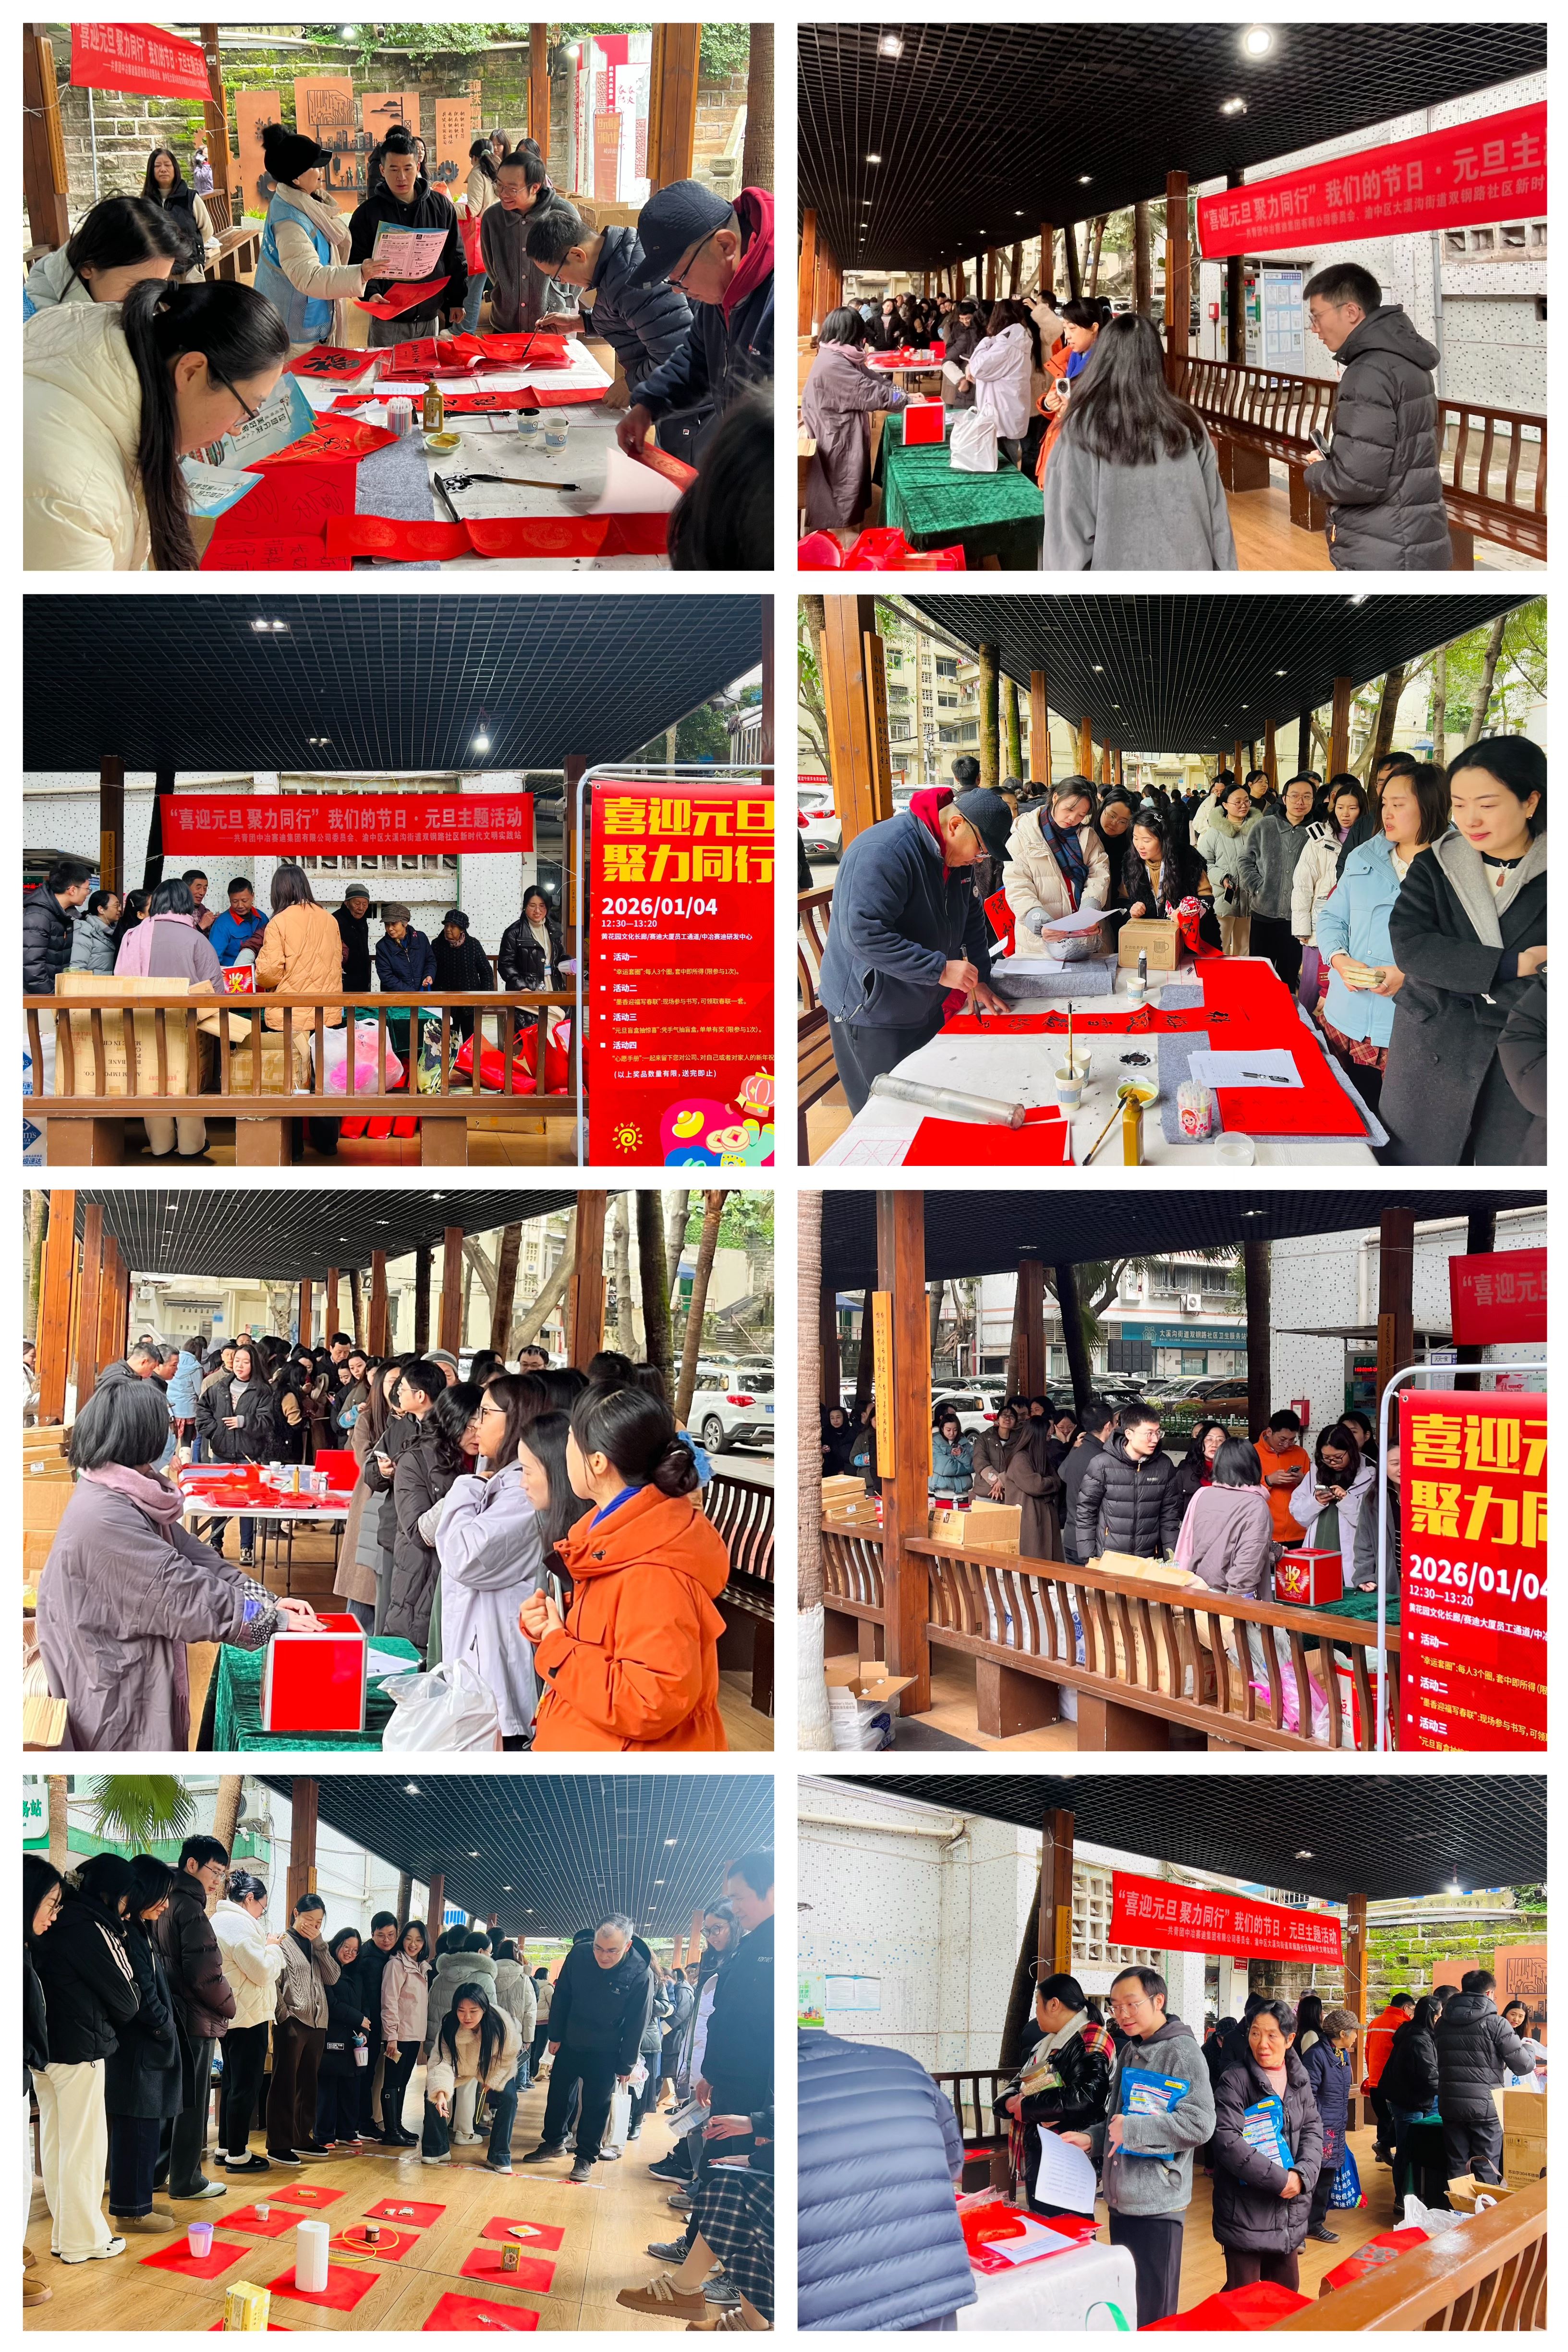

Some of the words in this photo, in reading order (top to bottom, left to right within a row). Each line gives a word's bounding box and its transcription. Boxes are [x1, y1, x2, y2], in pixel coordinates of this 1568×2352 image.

[1203, 202, 1252, 231] “喜迎元旦
[1253, 184, 1316, 222] 聚力同行”
[1325, 132, 1547, 207] 我们的节日·元旦主
[170, 808, 244, 830] “喜迎元旦
[247, 808, 320, 830] 聚力同行”
[328, 807, 523, 830] 我们的节日·元旦主题活动
[602, 797, 774, 837] 喜迎元旦
[602, 844, 774, 883] 聚力同行
[601, 896, 718, 919] 2026/01/04
[600, 933, 753, 941] 黄花园文化长廊/赛迪大厦员工通道/中冶赛迪研发中心
[613, 953, 638, 961] 活动一
[228, 972, 244, 993] 奖
[613, 984, 638, 993] 活动二
[612, 1013, 637, 1021] 活动三
[612, 1041, 637, 1050] 活动四
[1159, 1329, 1247, 1340] 大溪沟街道双钢路社区卫生服务站
[1285, 1564, 1301, 1593] 奖
[1420, 1632, 1449, 1648] 活动一
[1420, 1675, 1448, 1694] 活动二
[1419, 1716, 1448, 1735] 活动三
[1118, 1889, 1177, 1921] “喜迎元旦
[1179, 1902, 1230, 1929] 聚力同行”
[1234, 1911, 1337, 1945] 我们的节日·元旦主题活动
